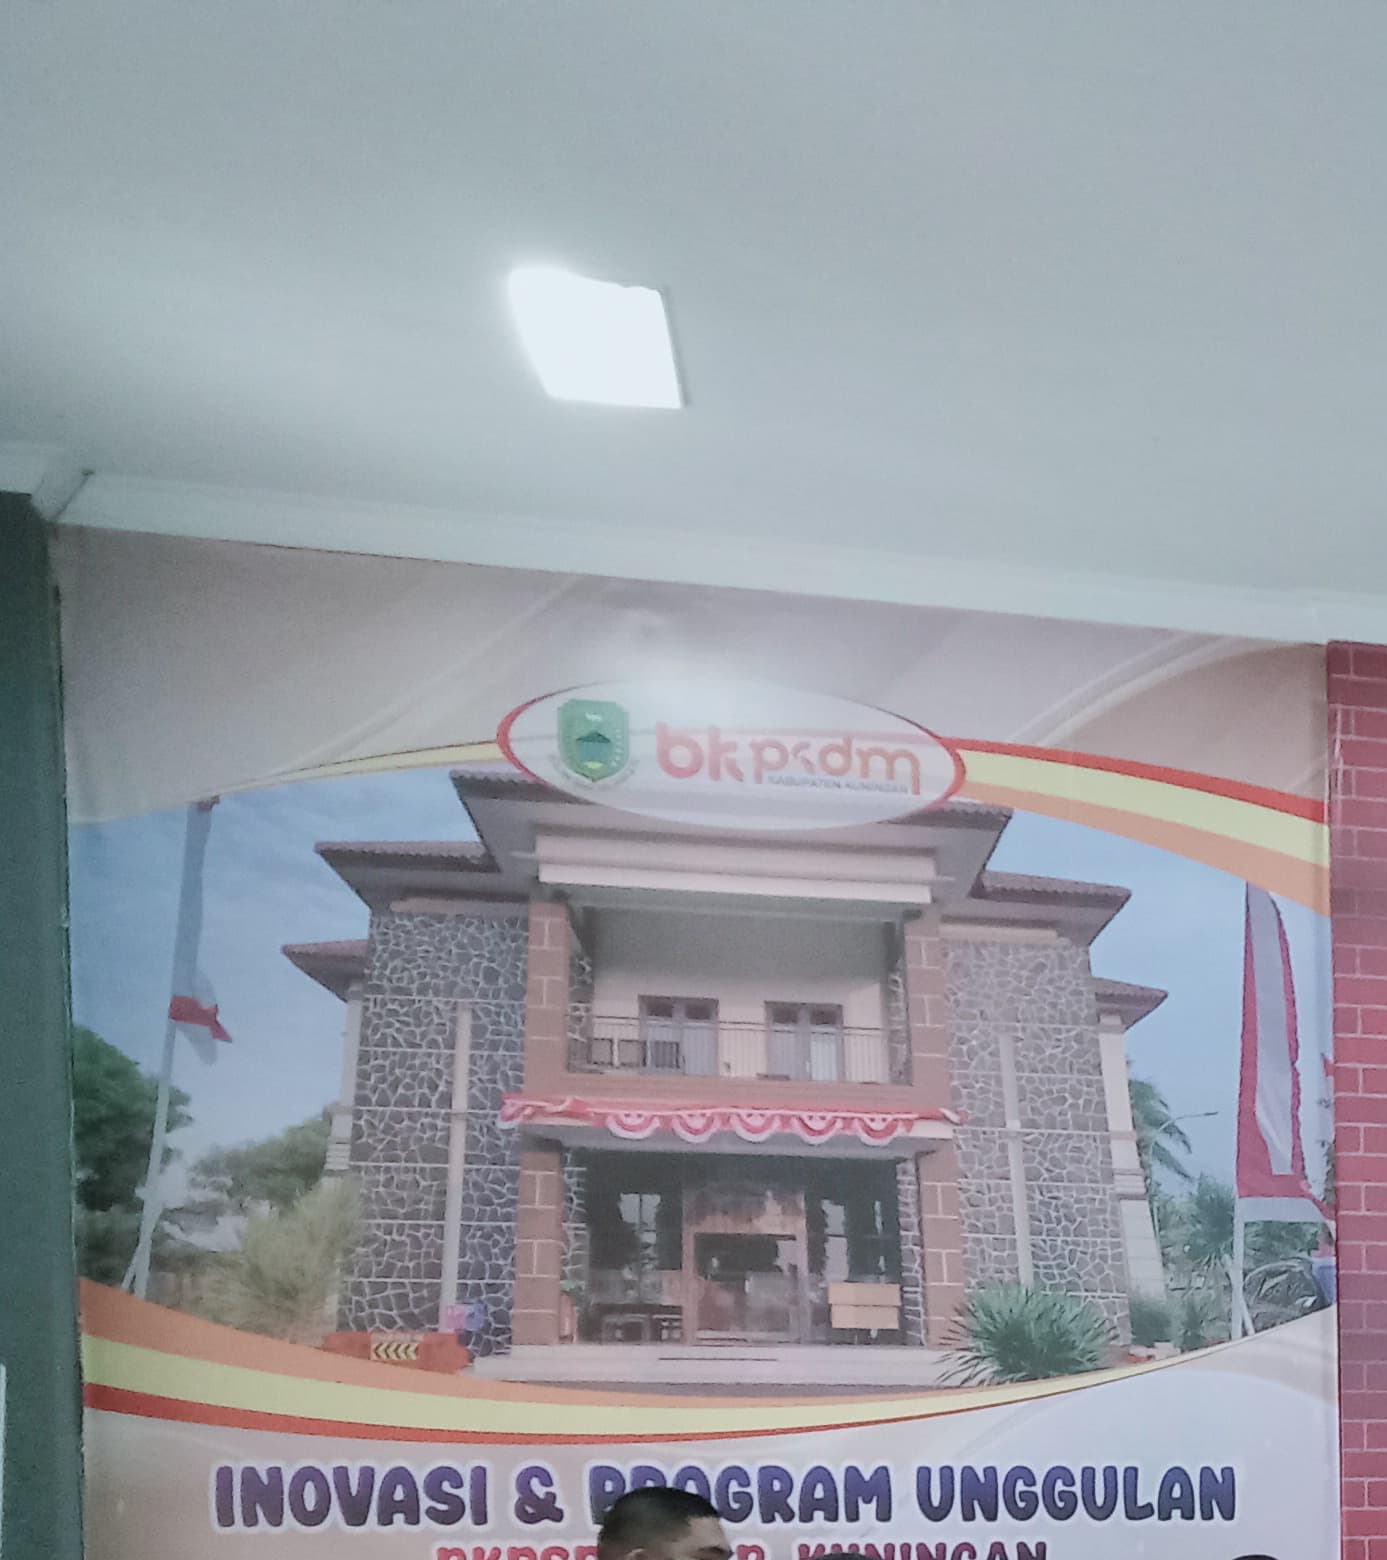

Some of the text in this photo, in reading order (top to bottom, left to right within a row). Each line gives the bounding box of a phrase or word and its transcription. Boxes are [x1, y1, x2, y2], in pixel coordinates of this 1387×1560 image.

[214, 1465, 488, 1528] INOVASI
[514, 1465, 563, 1524] &
[916, 1465, 1237, 1523] UNGGULAN
